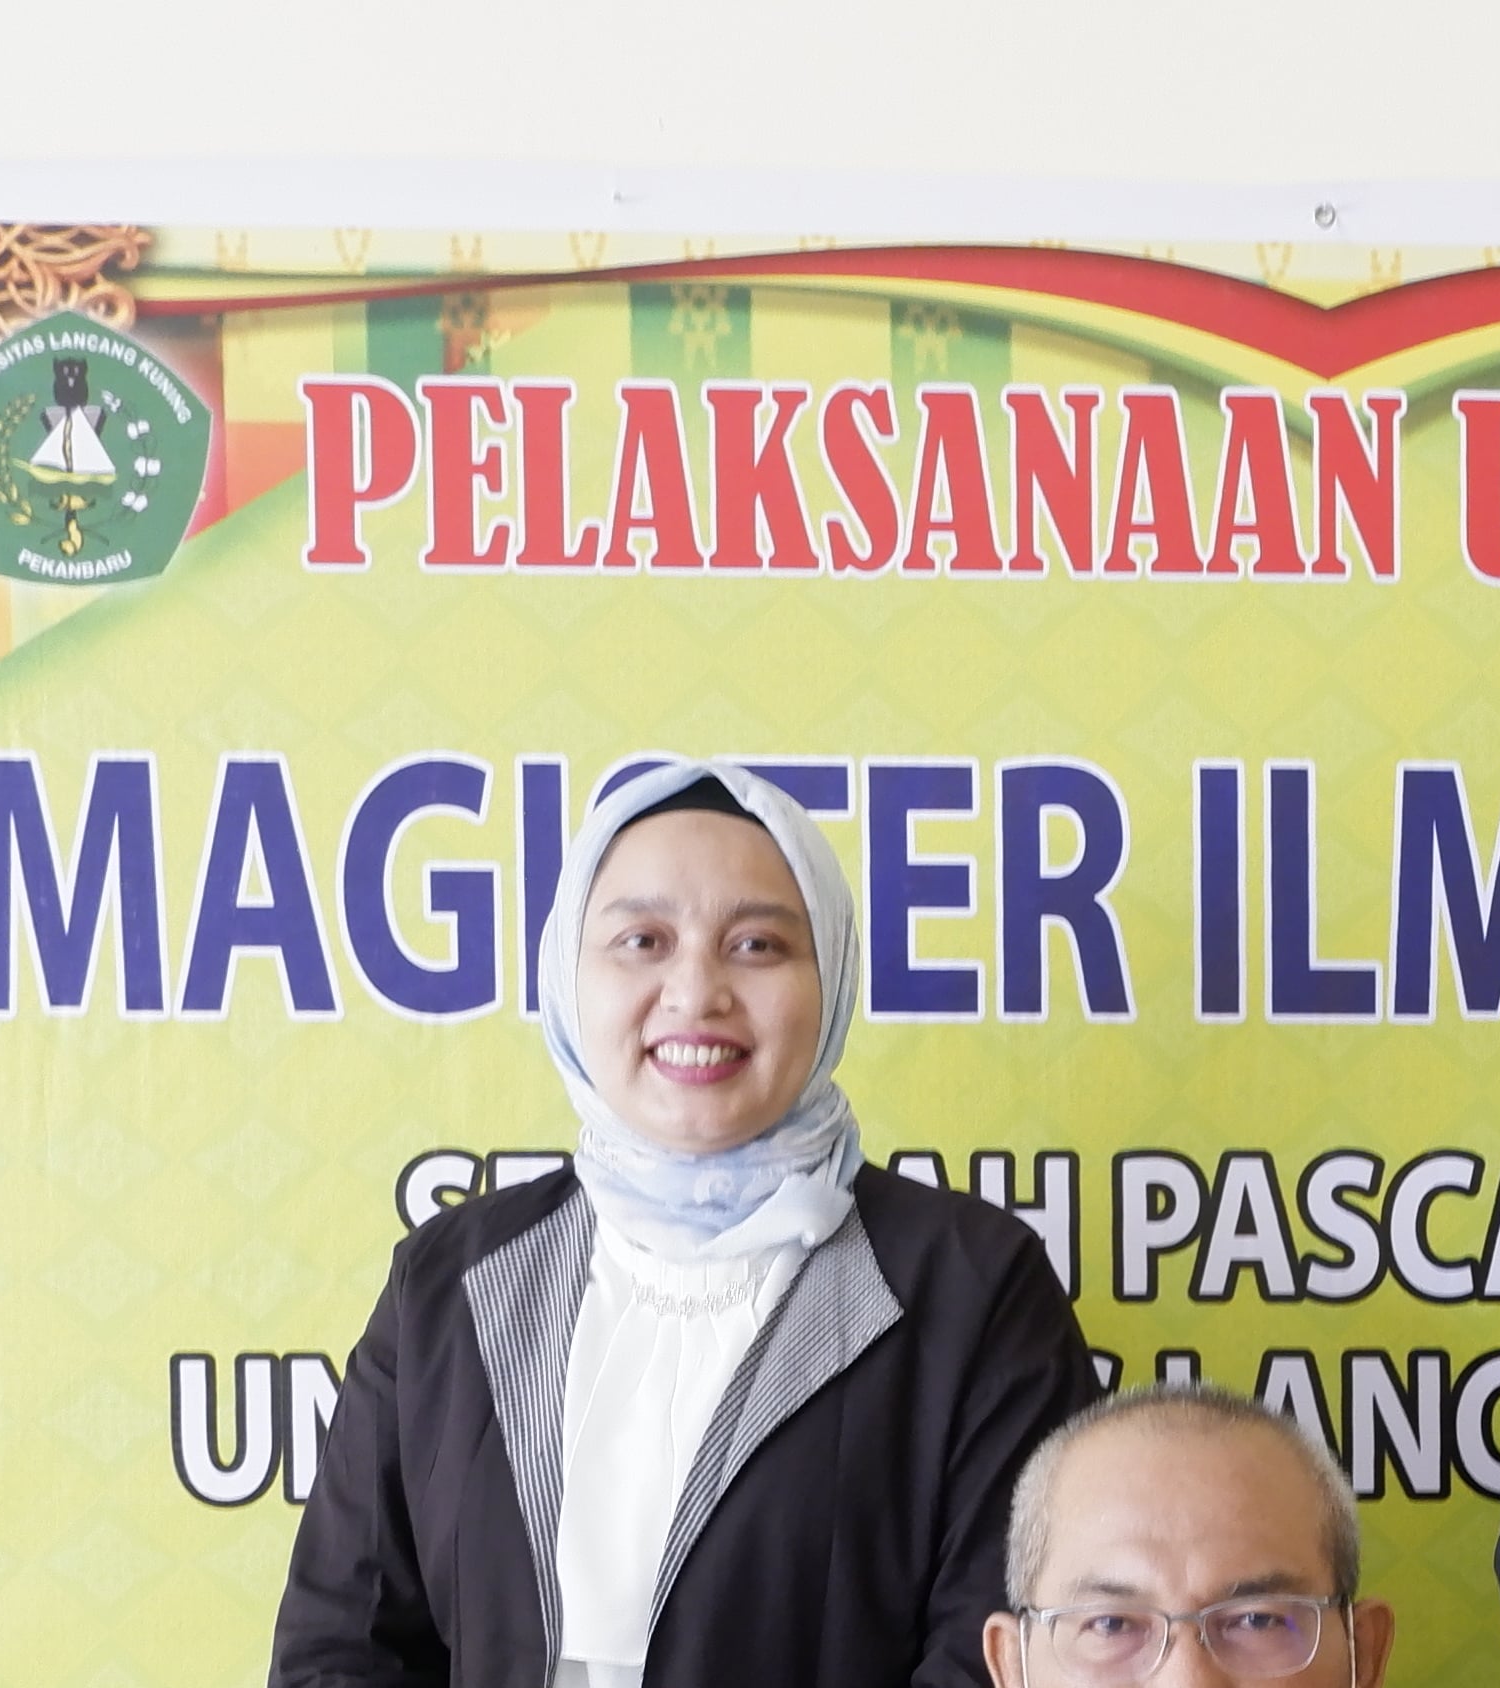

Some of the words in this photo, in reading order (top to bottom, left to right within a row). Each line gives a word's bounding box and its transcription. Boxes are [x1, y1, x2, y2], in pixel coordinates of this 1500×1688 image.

[48, 331, 138, 367] LANCANG
[137, 359, 193, 425] KUNING
[300, 378, 1408, 582] PELAKSANAAN
[17, 547, 133, 581] PEKANBARU
